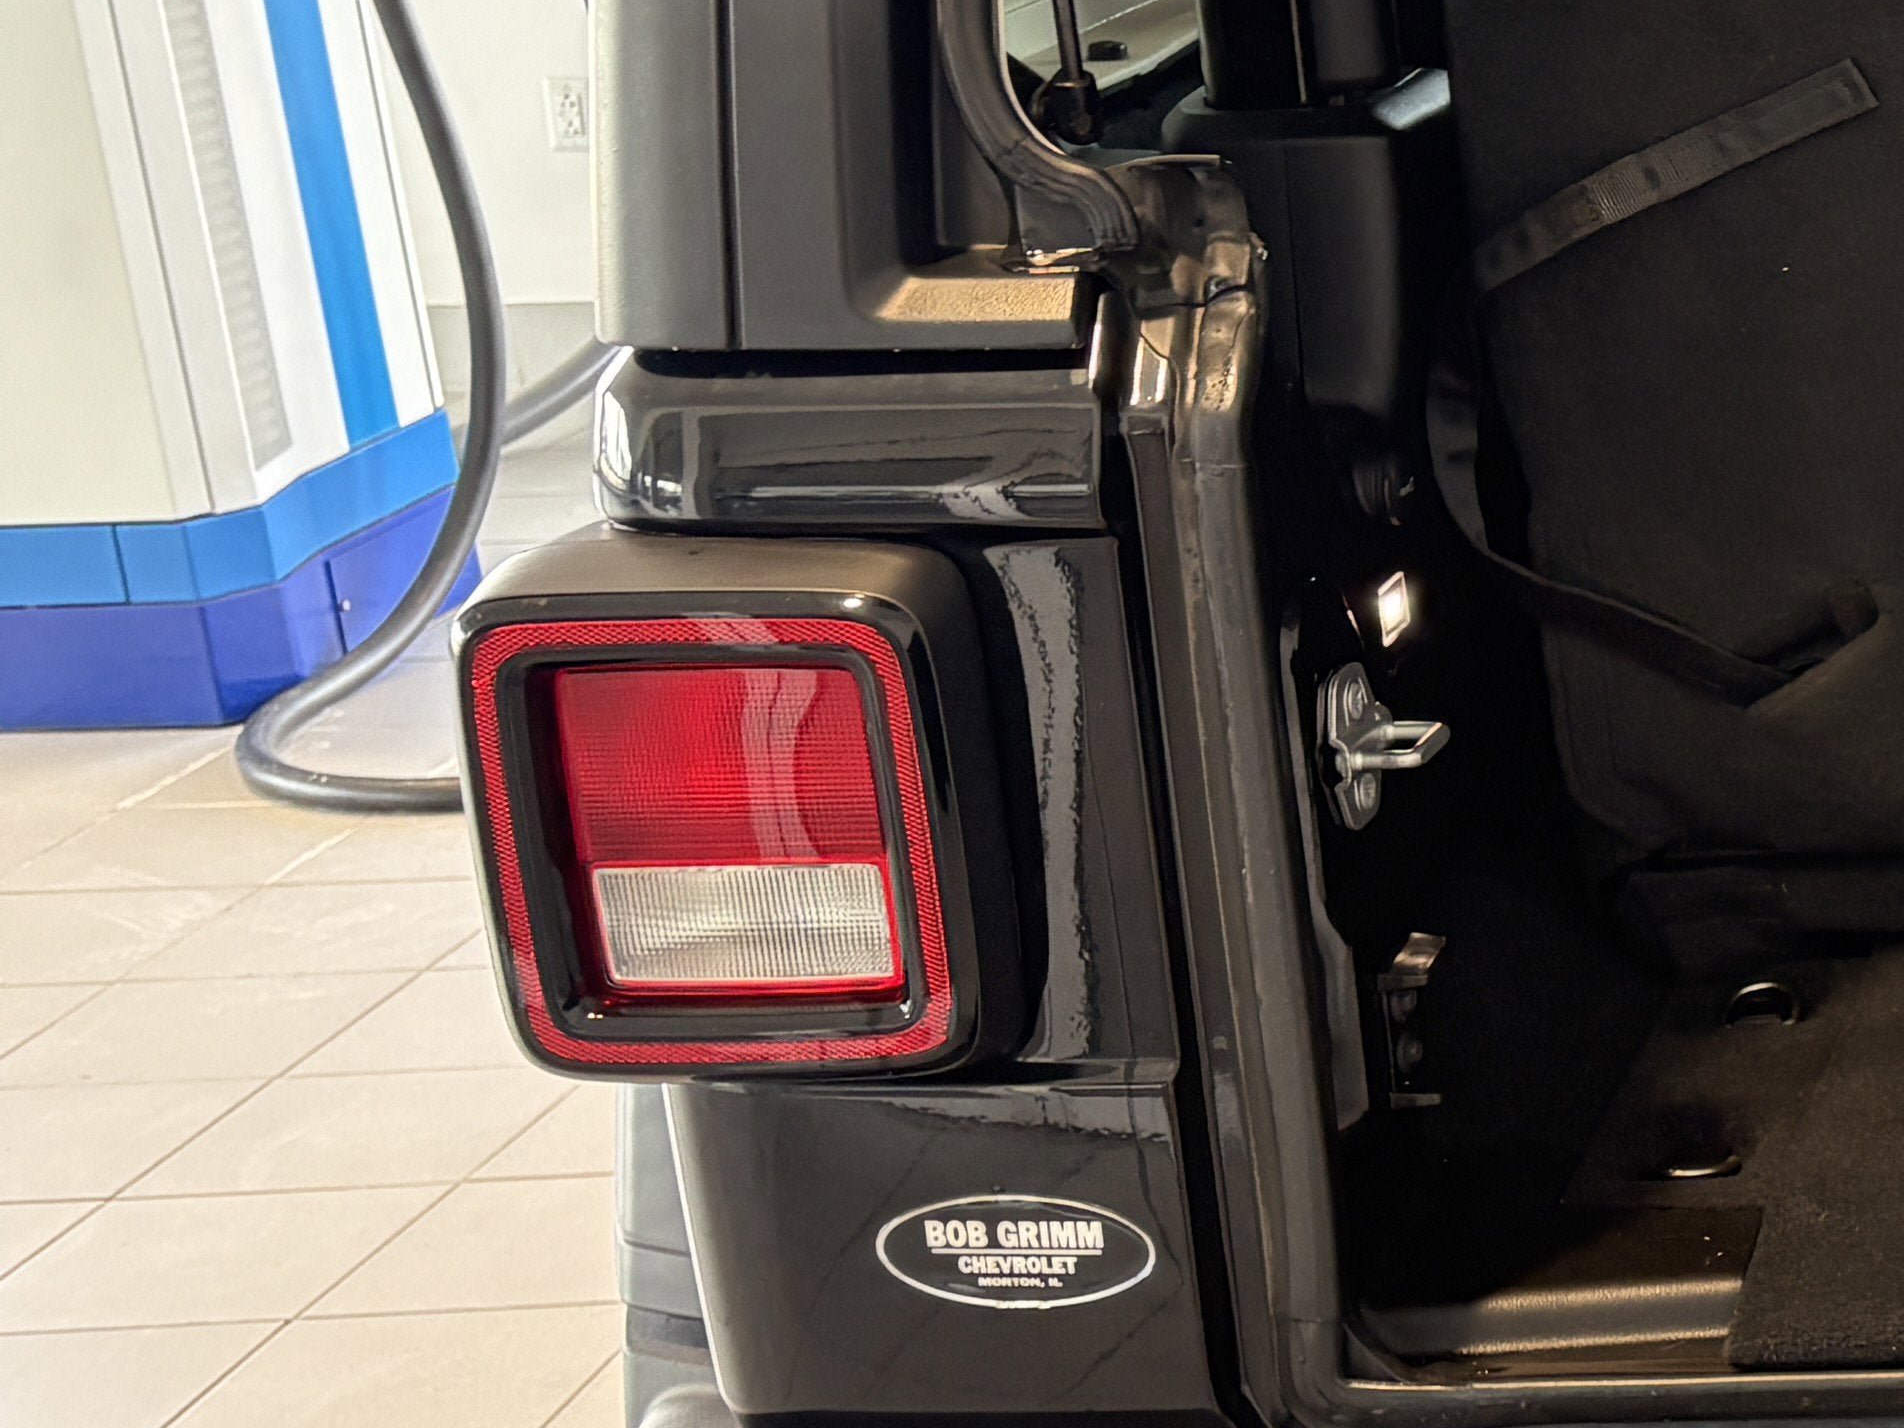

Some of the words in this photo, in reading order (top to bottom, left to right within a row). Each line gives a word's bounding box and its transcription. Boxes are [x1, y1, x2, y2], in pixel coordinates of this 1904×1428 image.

[924, 1219, 989, 1248] BOB
[996, 1220, 1105, 1249] GRIMM
[957, 1255, 1078, 1275] CHEVROLET
